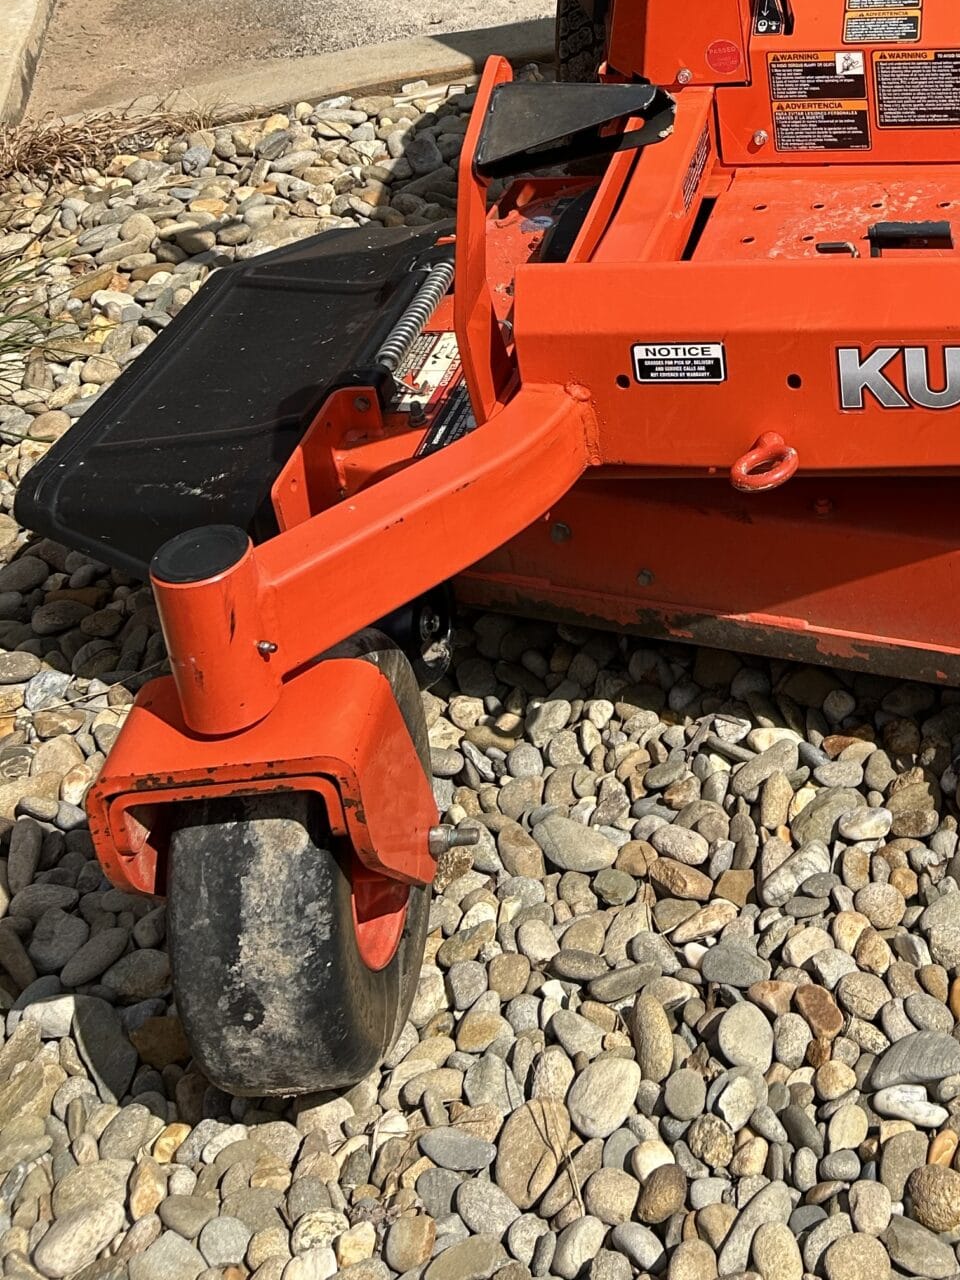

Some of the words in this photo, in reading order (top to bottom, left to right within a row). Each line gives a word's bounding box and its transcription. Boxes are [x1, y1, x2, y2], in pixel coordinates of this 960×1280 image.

[780, 53, 819, 61] WARNING
[887, 52, 928, 60] WARNING
[785, 102, 843, 110] ADVERTENCIA
[644, 346, 713, 357] NOTICE
